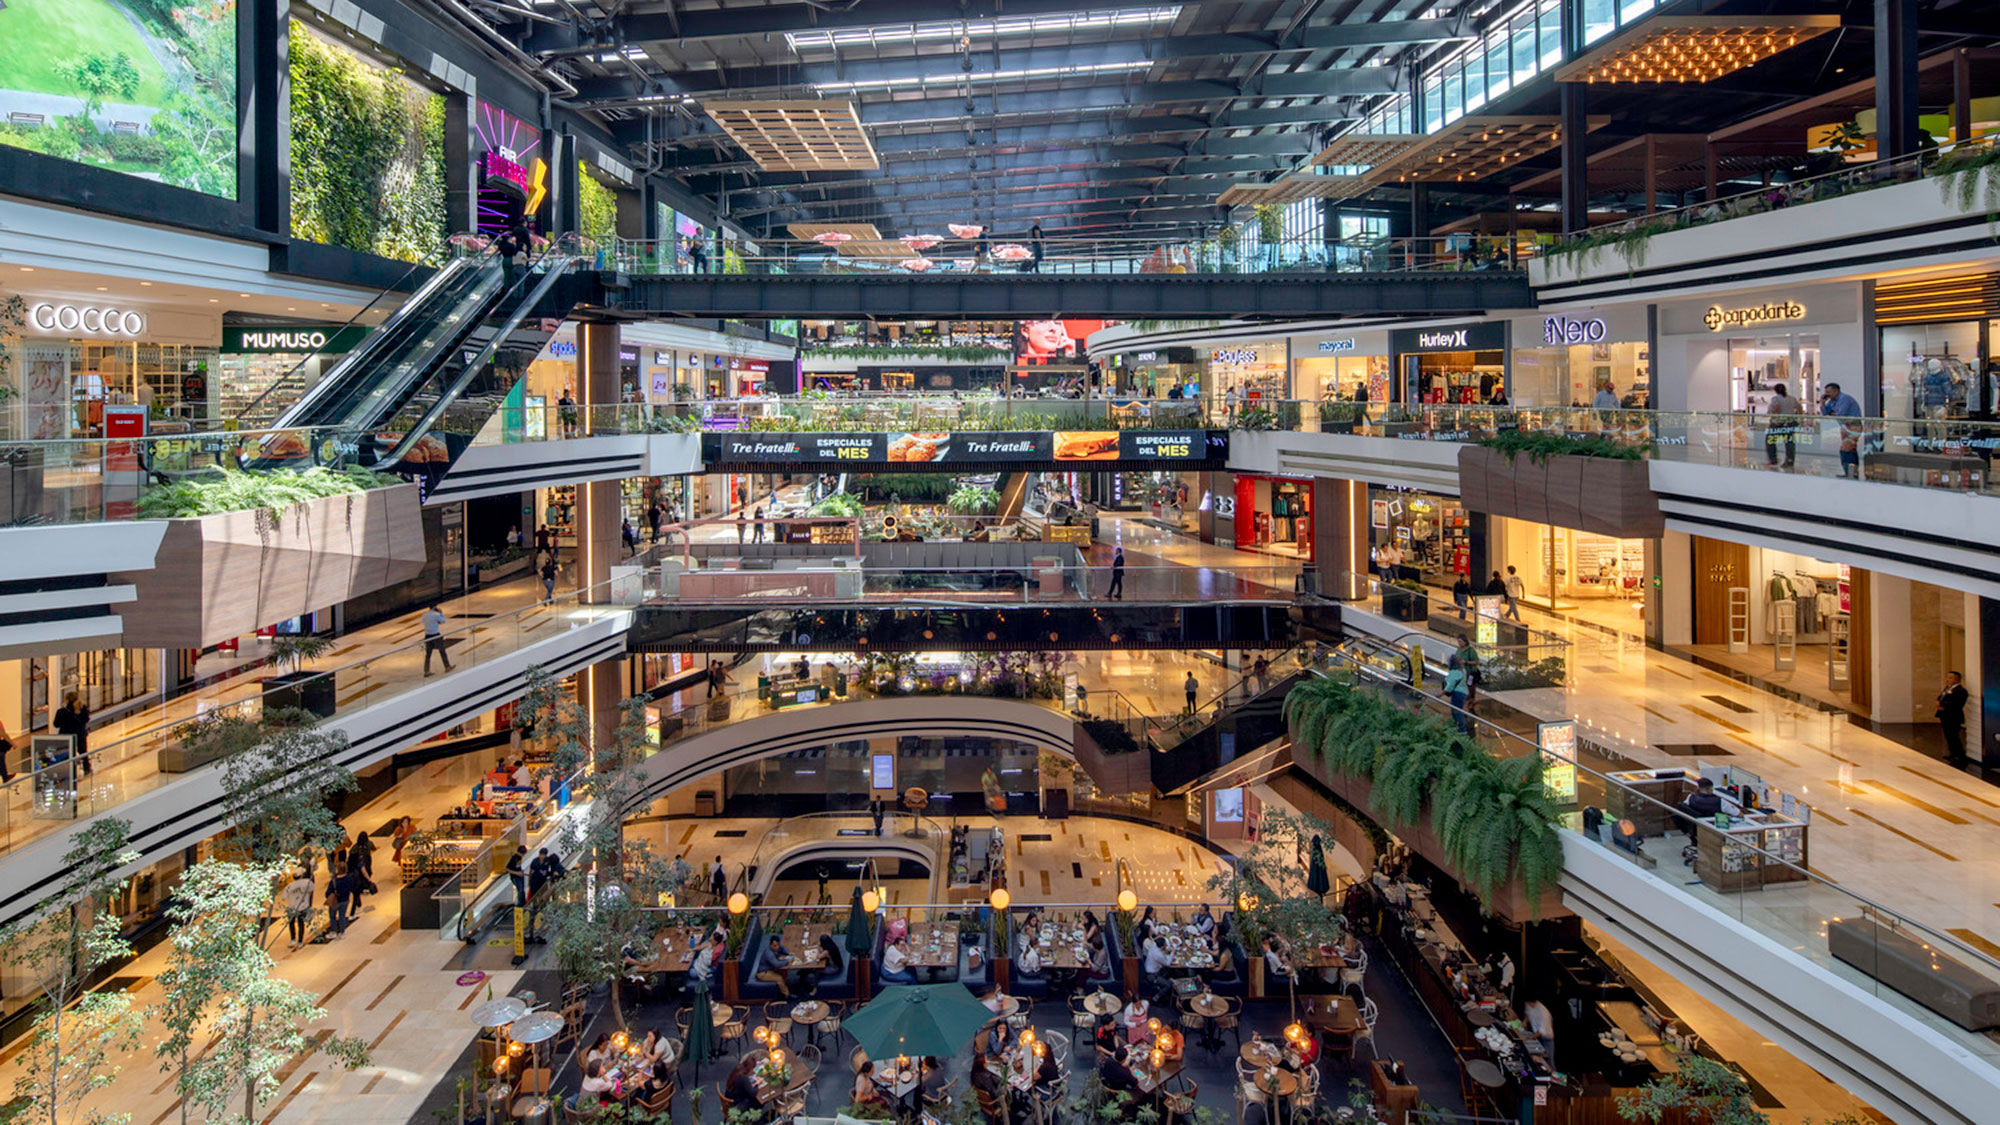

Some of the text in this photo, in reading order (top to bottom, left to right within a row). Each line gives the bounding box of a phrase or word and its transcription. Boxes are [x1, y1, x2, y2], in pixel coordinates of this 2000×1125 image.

[34, 303, 144, 335] GOCCO
[1723, 302, 1801, 326] capodarte
[1550, 317, 1605, 343] Nero
[242, 332, 326, 348] MUMUSO
[1318, 338, 1355, 352] mayoral
[1419, 332, 1455, 348] Hurley
[1218, 350, 1257, 365] Payless
[732, 442, 794, 453] Tre Fratelli
[817, 439, 872, 447] ESPECIALES
[968, 441, 1029, 453] Tre Fratelli
[1136, 436, 1191, 445] ESPECIALES
[838, 448, 869, 459] MES
[1158, 445, 1189, 456] MES
